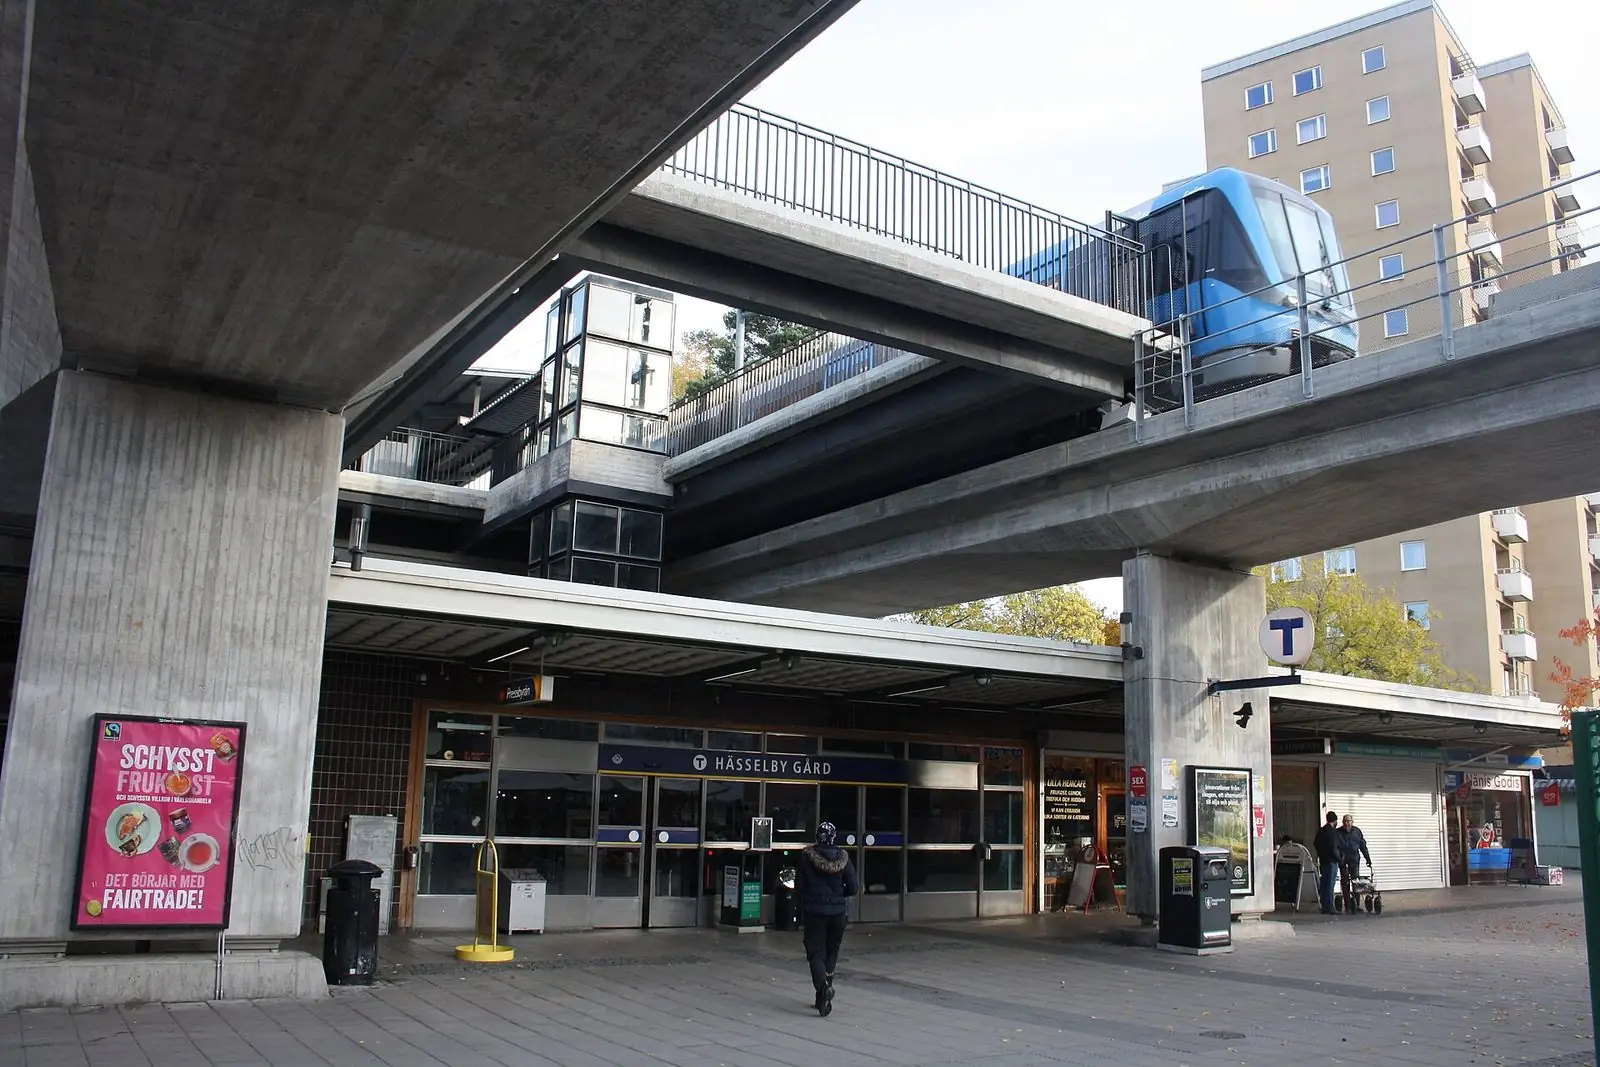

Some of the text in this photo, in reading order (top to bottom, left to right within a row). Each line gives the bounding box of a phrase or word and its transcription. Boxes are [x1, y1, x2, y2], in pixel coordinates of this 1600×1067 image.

[1269, 616, 1304, 656] T
[506, 684, 531, 700] Pressbyrån
[119, 743, 217, 774] SCHYSST
[715, 755, 788, 773] HÄSSELBY
[793, 757, 831, 775] GÅRD
[1131, 777, 1145, 785] SEX
[1493, 775, 1520, 789] Godis
[105, 872, 130, 888] DET
[131, 871, 177, 889] BÖRJAR
[179, 874, 205, 889] MED
[102, 888, 205, 910] FAIRTRADE!
